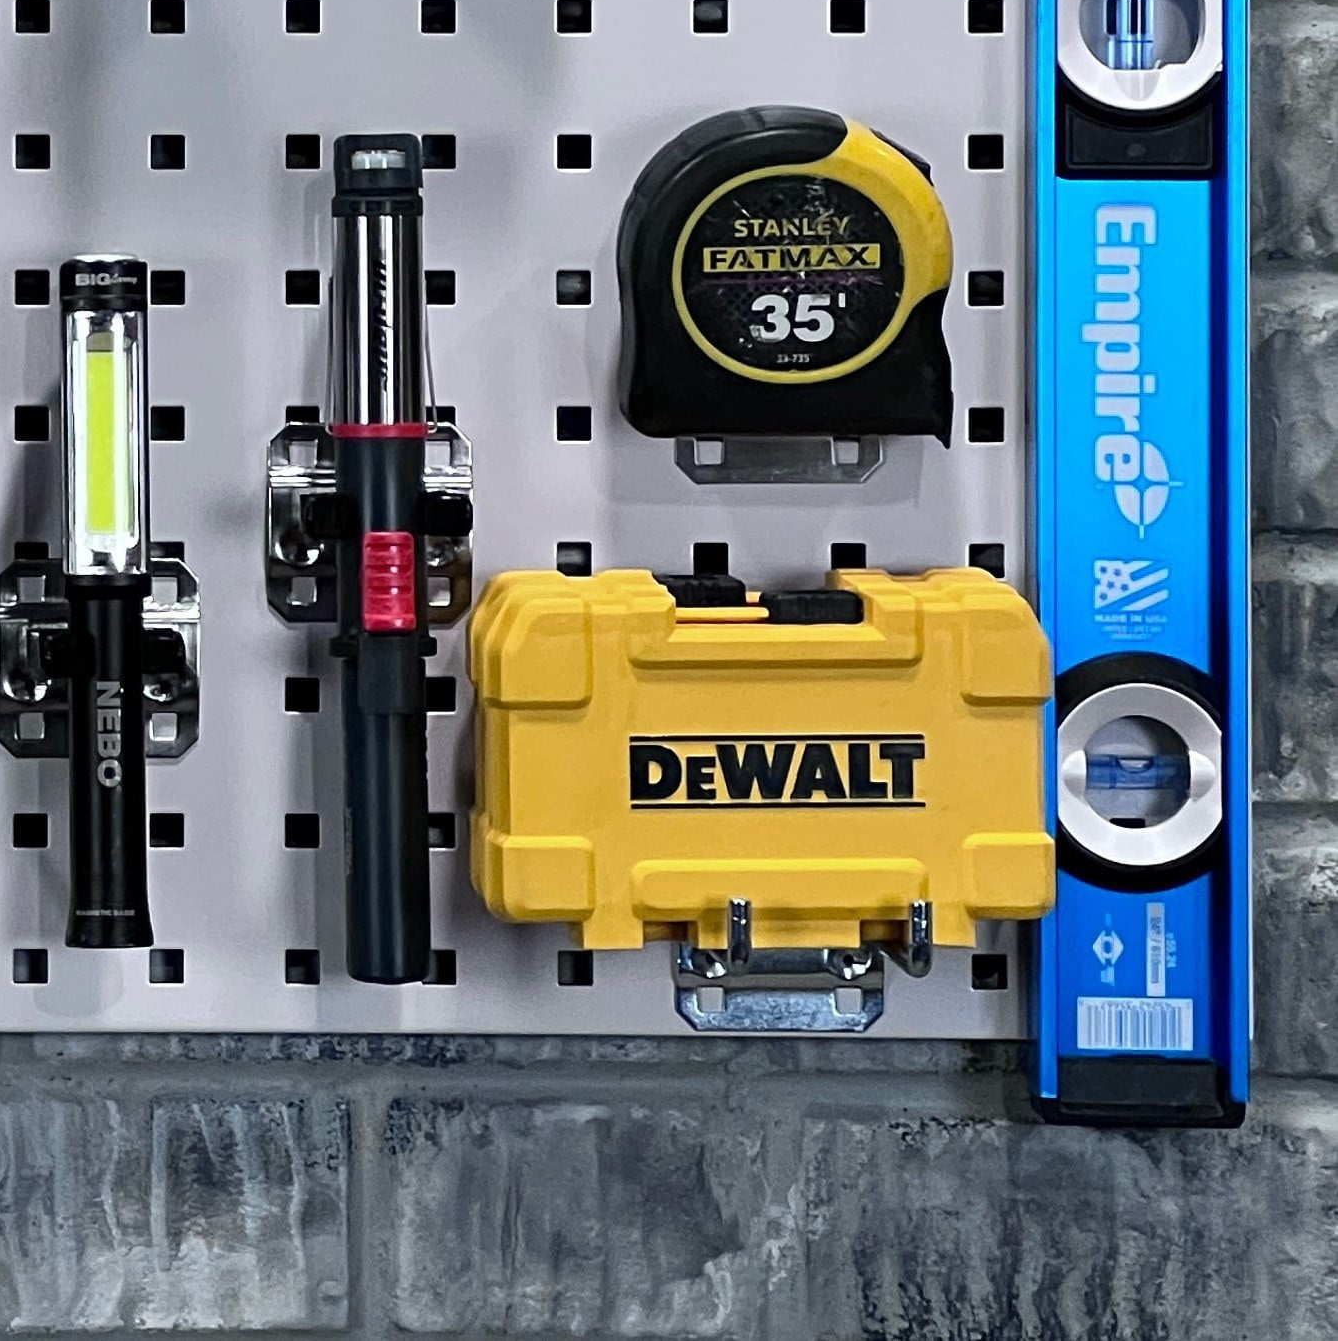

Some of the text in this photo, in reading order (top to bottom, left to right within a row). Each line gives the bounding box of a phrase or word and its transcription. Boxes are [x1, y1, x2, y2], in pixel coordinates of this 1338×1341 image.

[734, 216, 851, 238] STANLEY
[709, 246, 871, 269] FATMAX
[75, 273, 110, 286] BIG
[749, 292, 847, 343] 35'
[1082, 205, 1156, 483] Empire
[96, 680, 123, 788] NEBO
